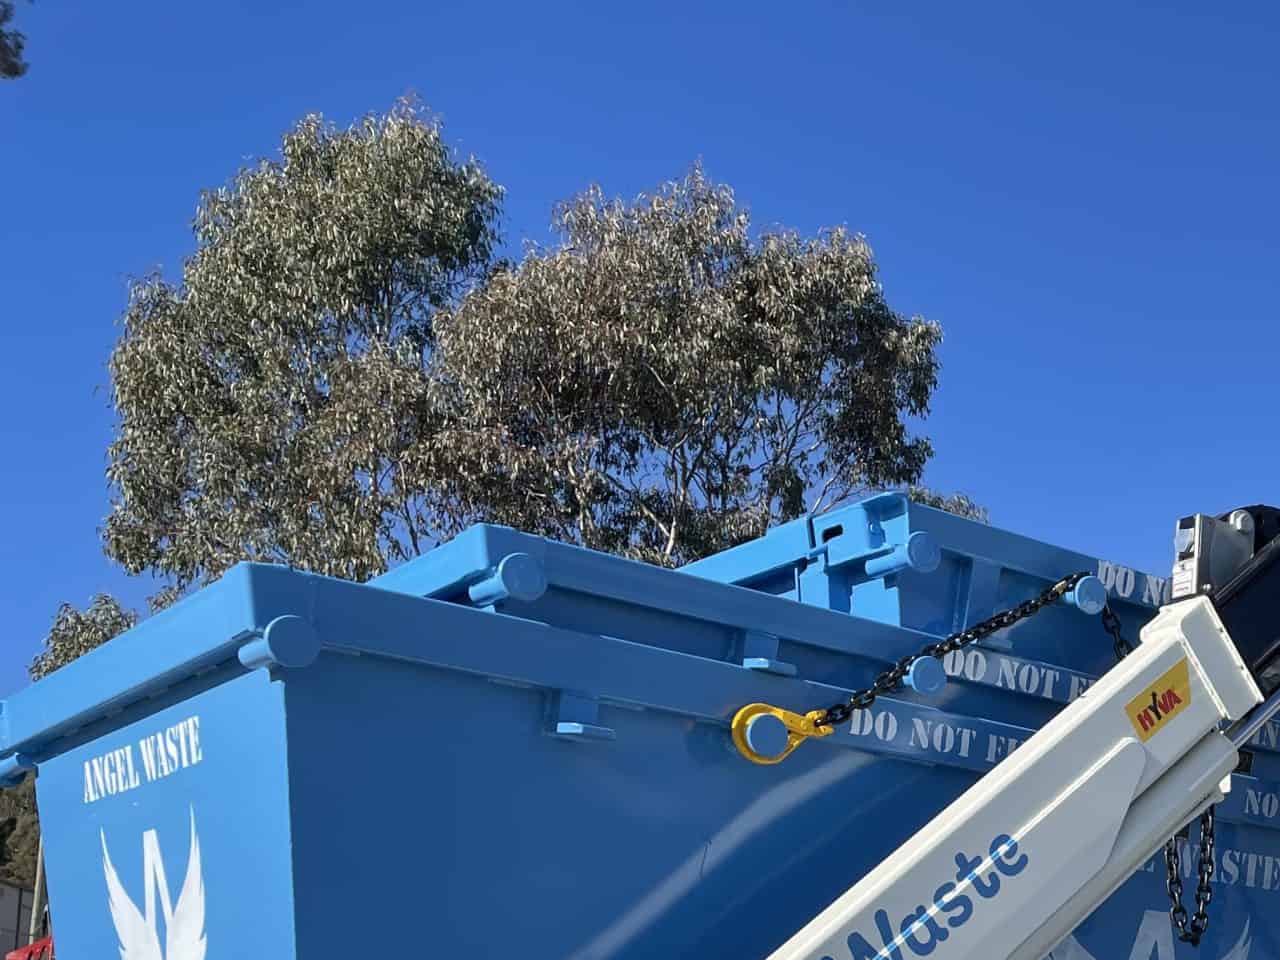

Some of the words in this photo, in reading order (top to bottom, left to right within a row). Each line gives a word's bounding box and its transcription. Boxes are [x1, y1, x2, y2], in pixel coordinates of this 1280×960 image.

[943, 649, 986, 681] DO
[995, 657, 1059, 699] NOT
[1136, 687, 1183, 732] HYVA
[83, 745, 140, 804] ANGEL
[139, 715, 203, 782] WASTE
[850, 708, 898, 741] DO
[908, 717, 977, 757] NOT
[1243, 789, 1279, 818] NO
